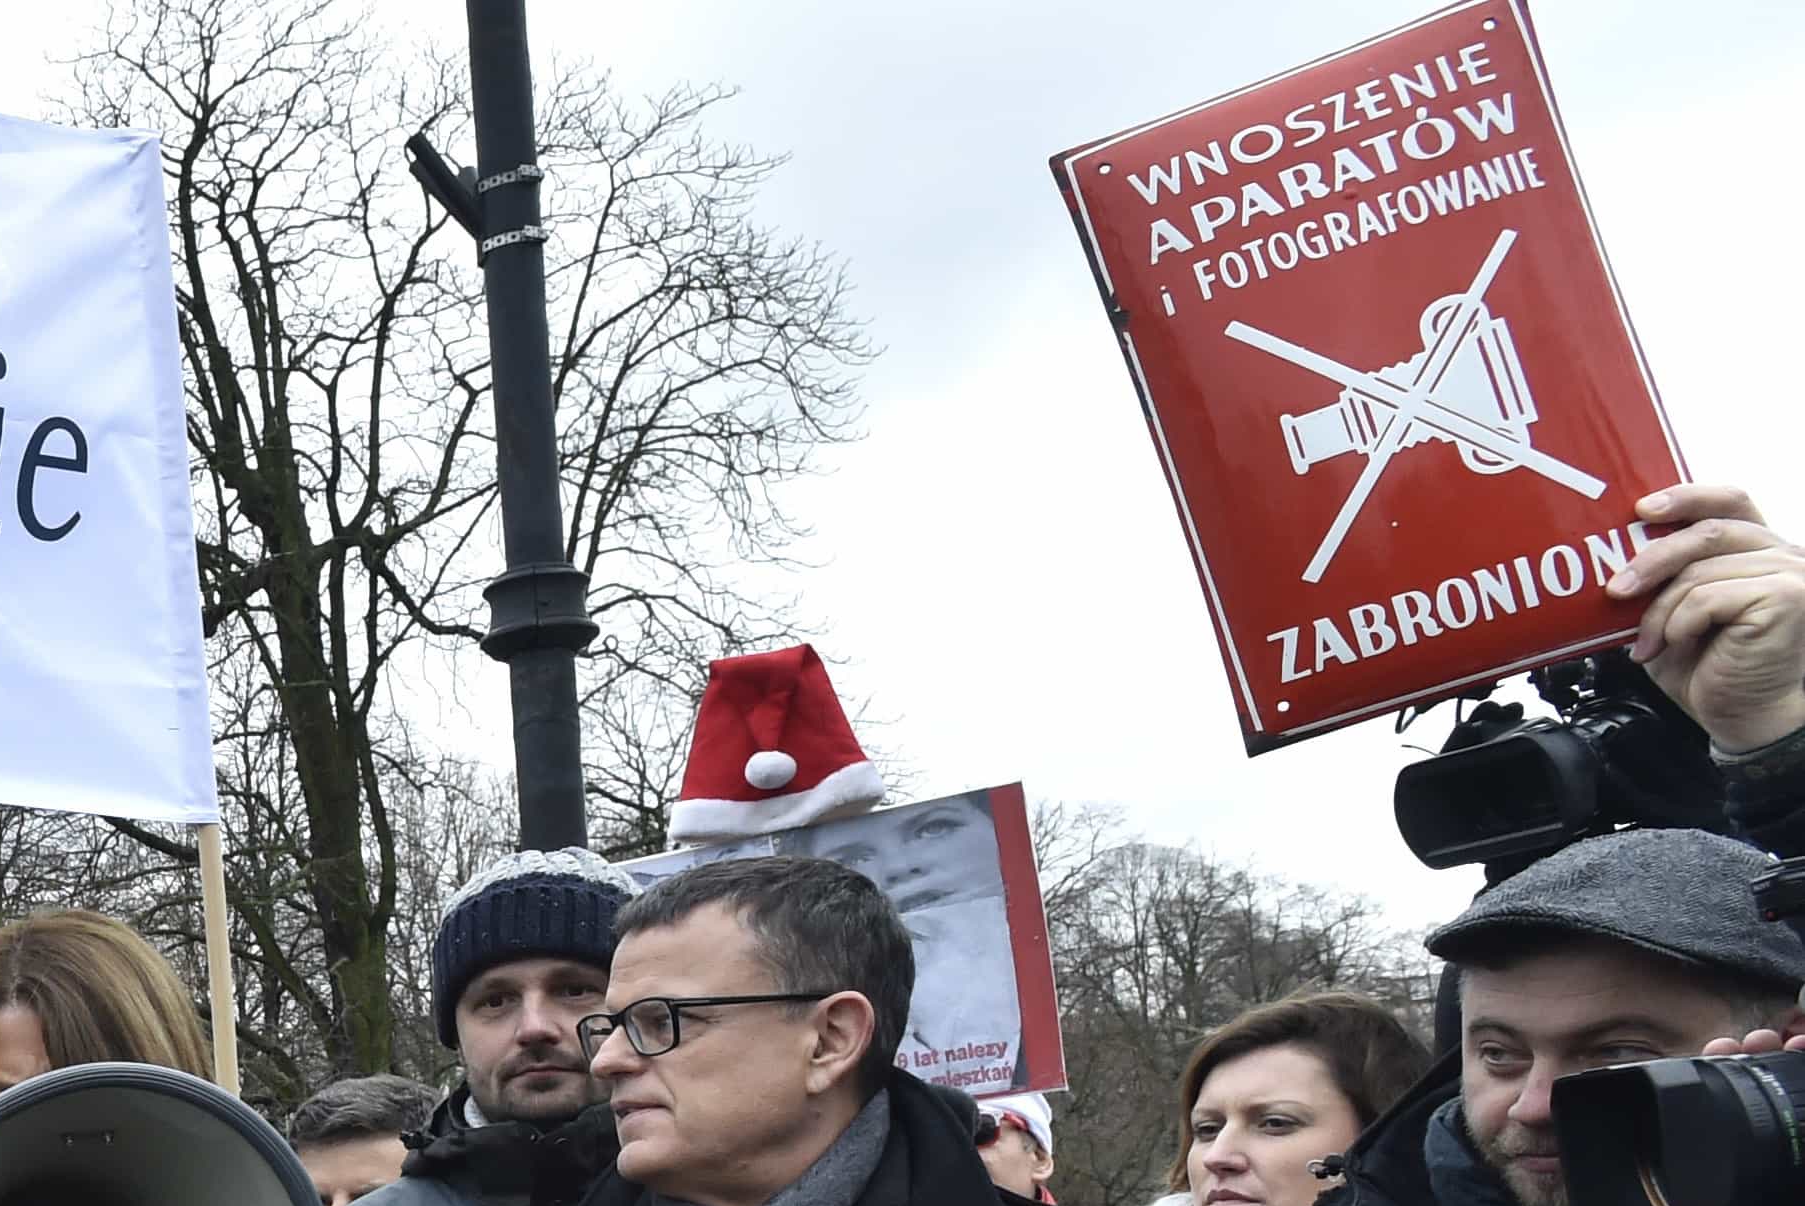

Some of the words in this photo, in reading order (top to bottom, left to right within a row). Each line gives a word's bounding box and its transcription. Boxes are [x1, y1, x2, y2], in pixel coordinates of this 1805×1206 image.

[1126, 42, 1497, 206] WNOSZENIE
[1149, 92, 1516, 266] APARATÓW
[1158, 284, 1177, 318] i
[1192, 147, 1547, 302] FOTOGRAFOWANIE
[913, 1048, 940, 1068] lat
